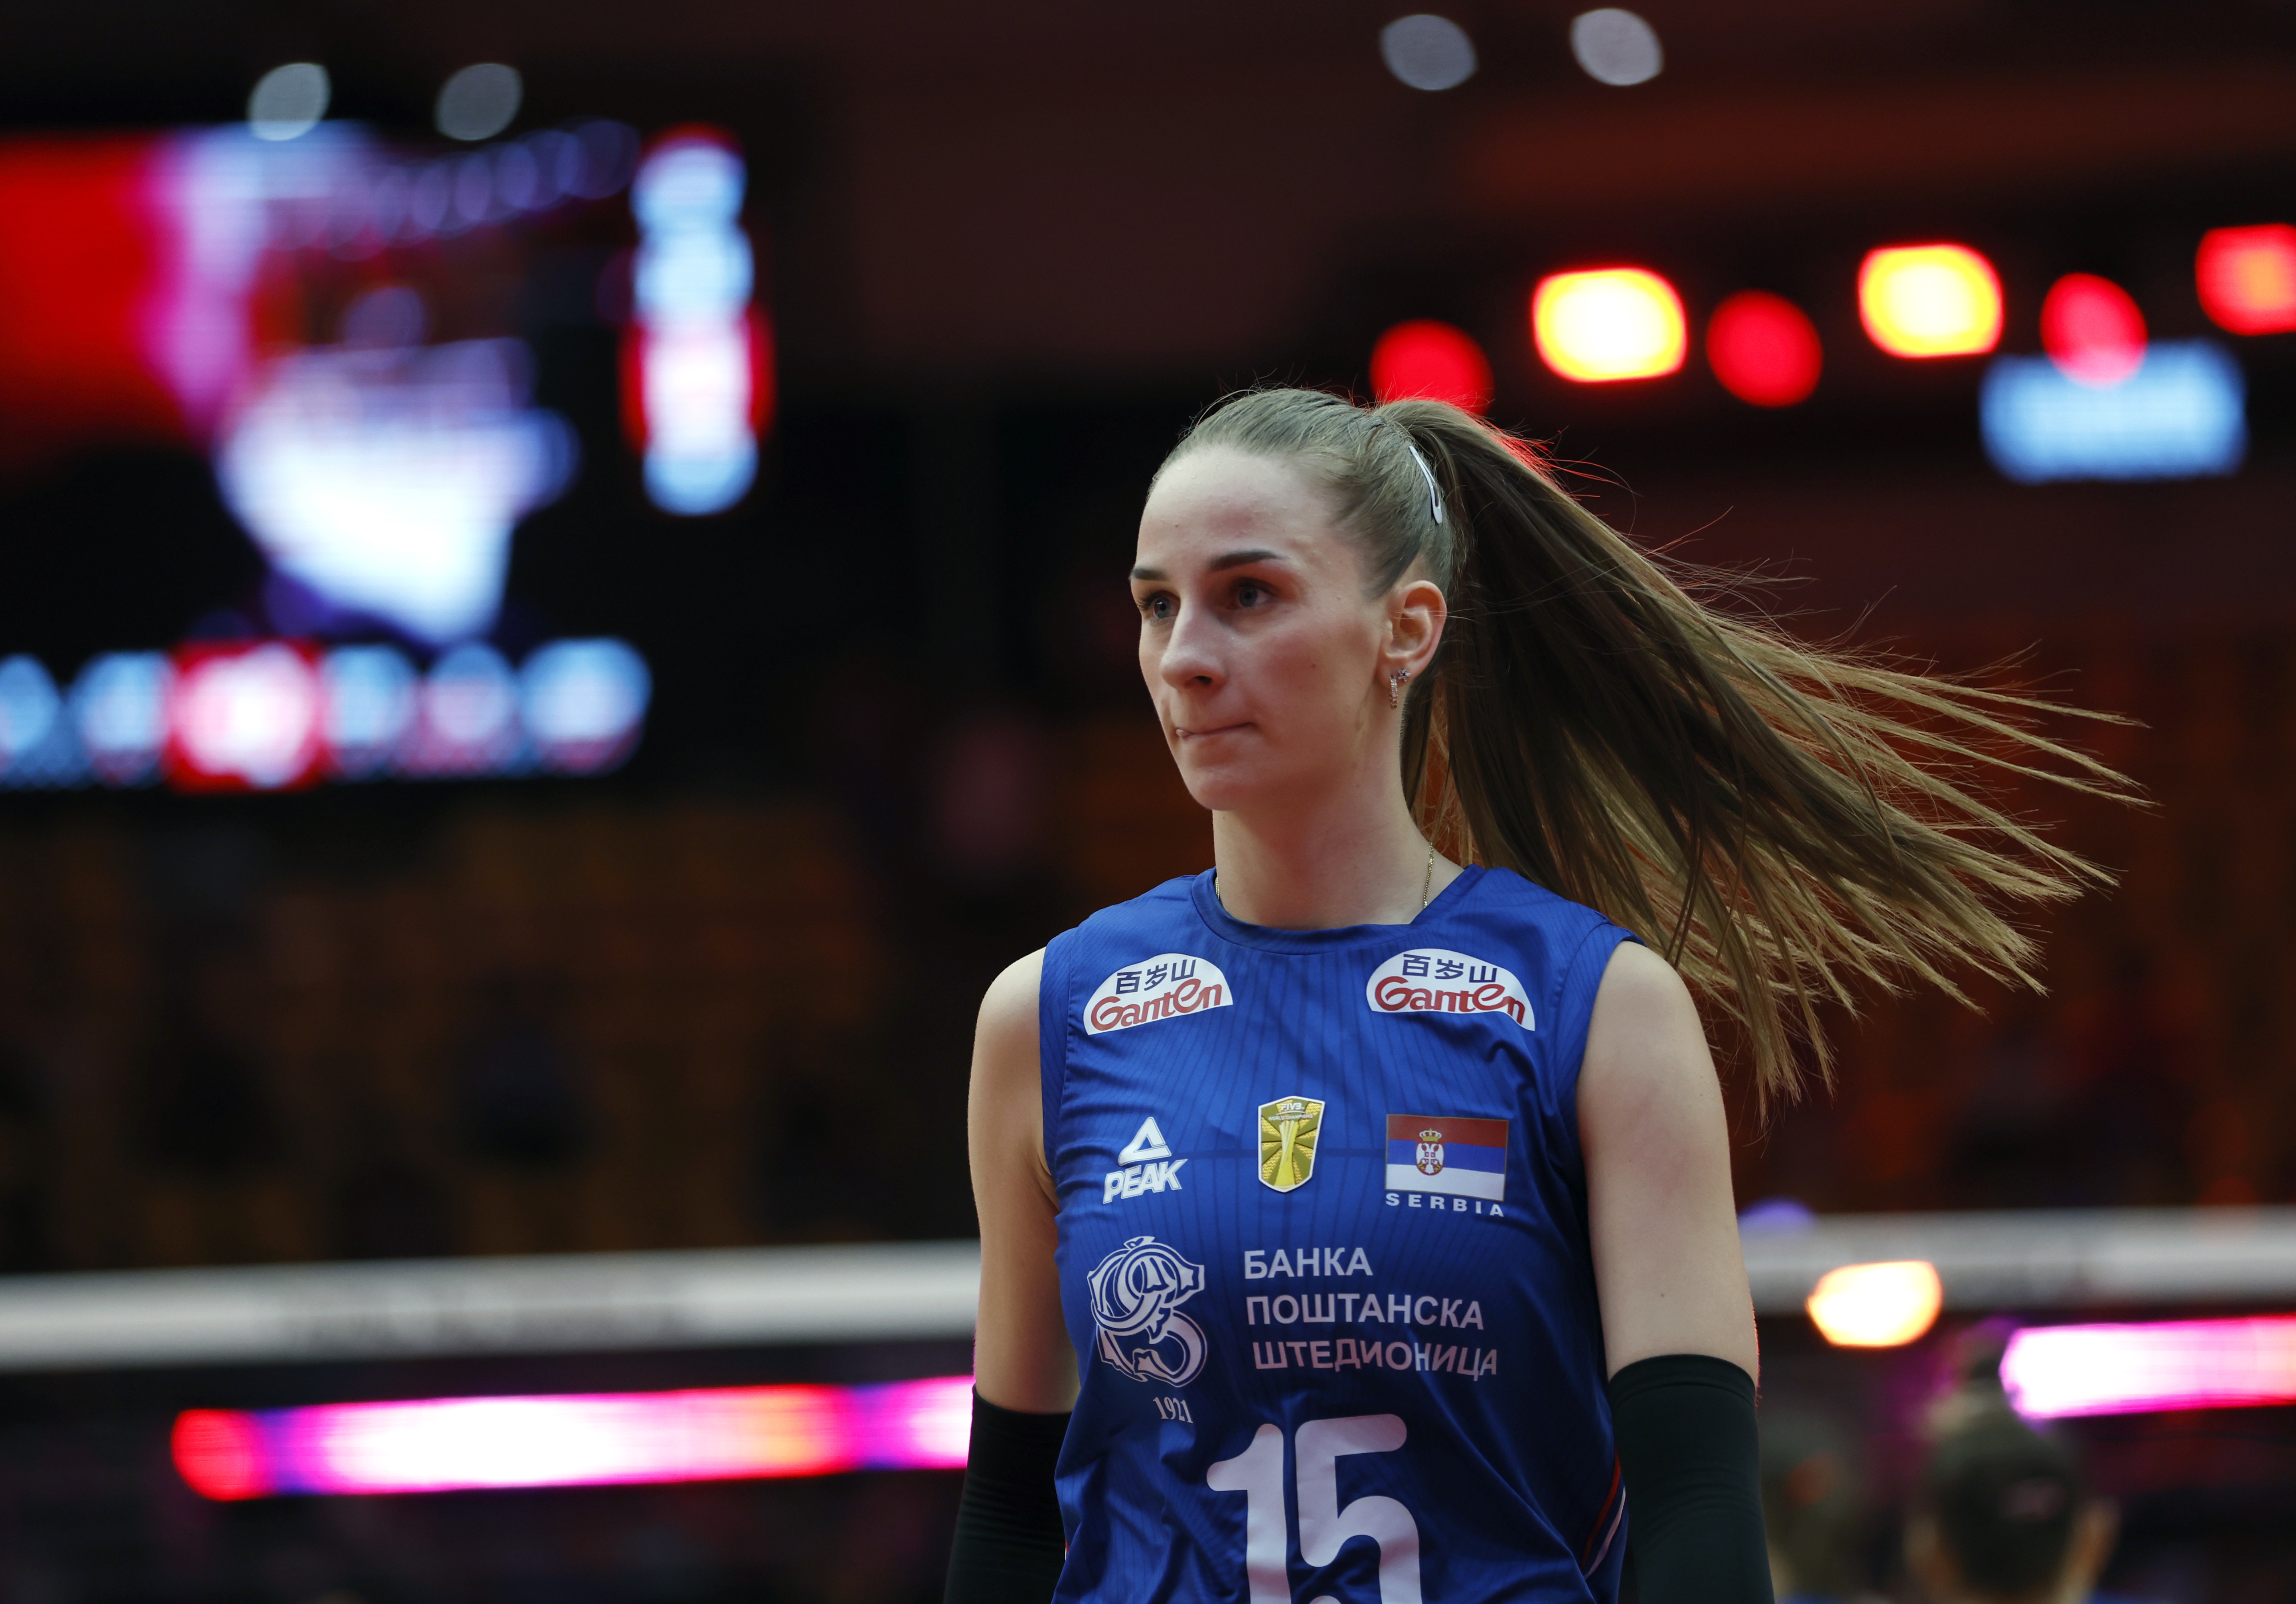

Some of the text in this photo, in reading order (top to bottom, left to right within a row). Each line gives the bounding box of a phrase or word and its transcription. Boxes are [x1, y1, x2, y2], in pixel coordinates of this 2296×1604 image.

[1116, 959, 1196, 994] 百岁山
[1402, 954, 1497, 983] 百岁山
[1091, 978, 1222, 1031] Ganten
[1375, 976, 1525, 1025] Ganten
[1103, 1159, 1188, 1204] PEAK
[1386, 1193, 1504, 1217] SERBIA
[1244, 1248, 1373, 1279] БАНКА
[1246, 1294, 1484, 1330] ПОШТАНСКА
[1252, 1339, 1497, 1381] ШТЕДИОНИЦА
[1153, 1397, 1193, 1424] 1921
[1206, 1414, 1422, 1604] 15
